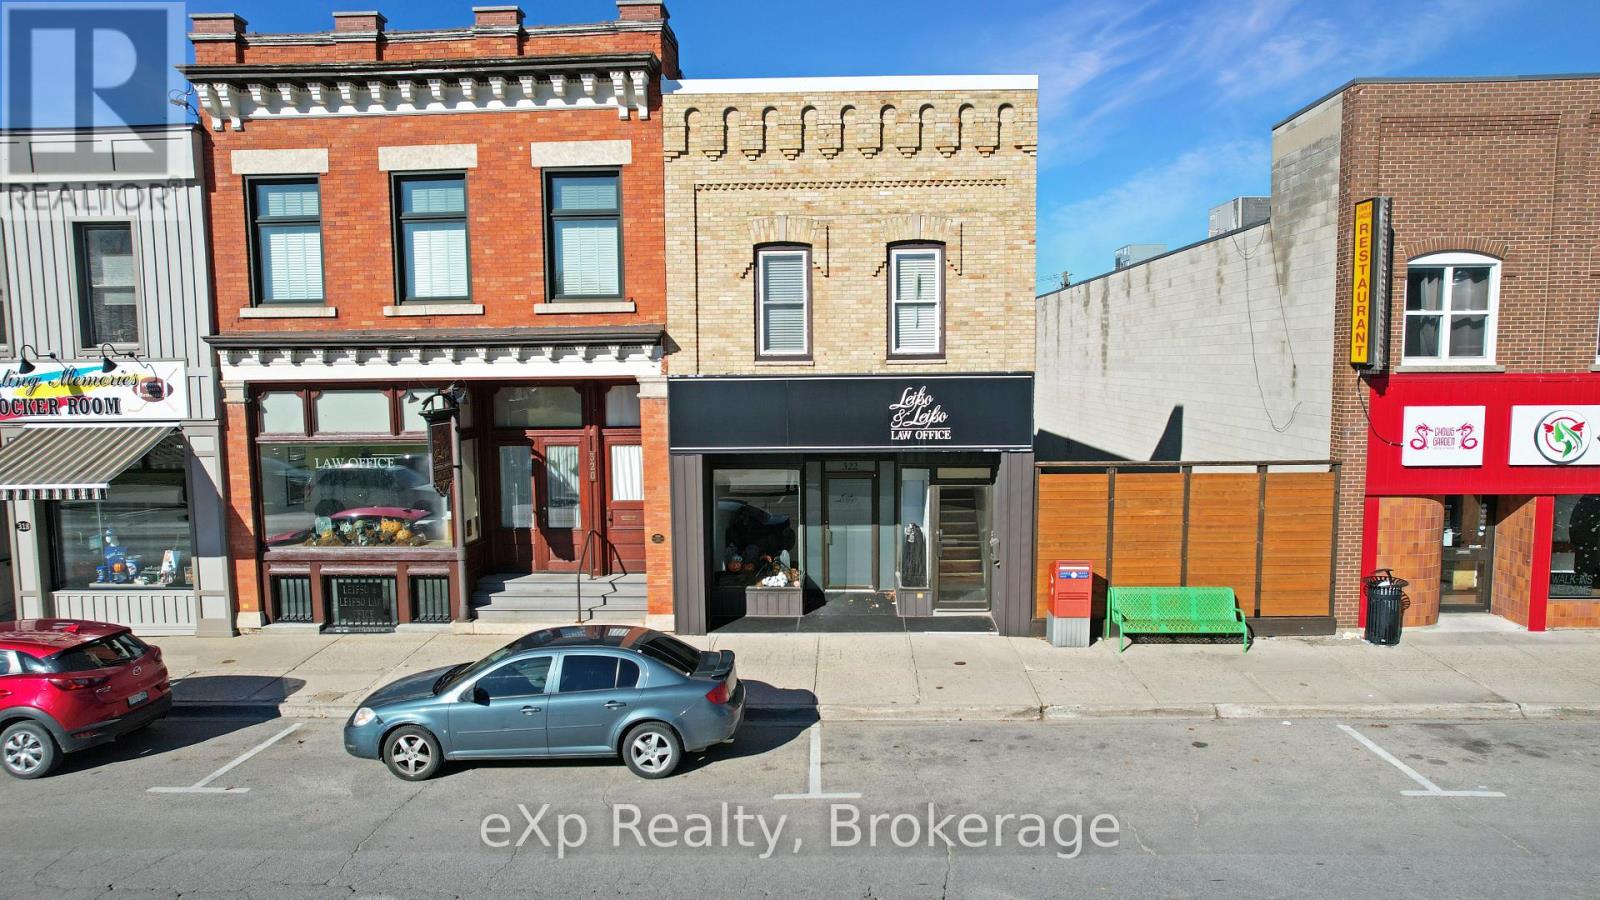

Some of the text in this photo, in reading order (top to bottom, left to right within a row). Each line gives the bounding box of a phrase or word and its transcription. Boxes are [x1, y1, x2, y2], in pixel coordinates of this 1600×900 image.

[1355, 223, 1369, 357] RESTAURANT
[48, 366, 138, 388] Memories
[0, 397, 122, 416] OCKER ROOM
[889, 385, 934, 413] Leifso
[890, 404, 949, 429] & Leifso
[890, 430, 952, 440] LAW OFFICE
[1432, 437, 1456, 446] GARDEN
[314, 457, 396, 469] LAW OFFICE
